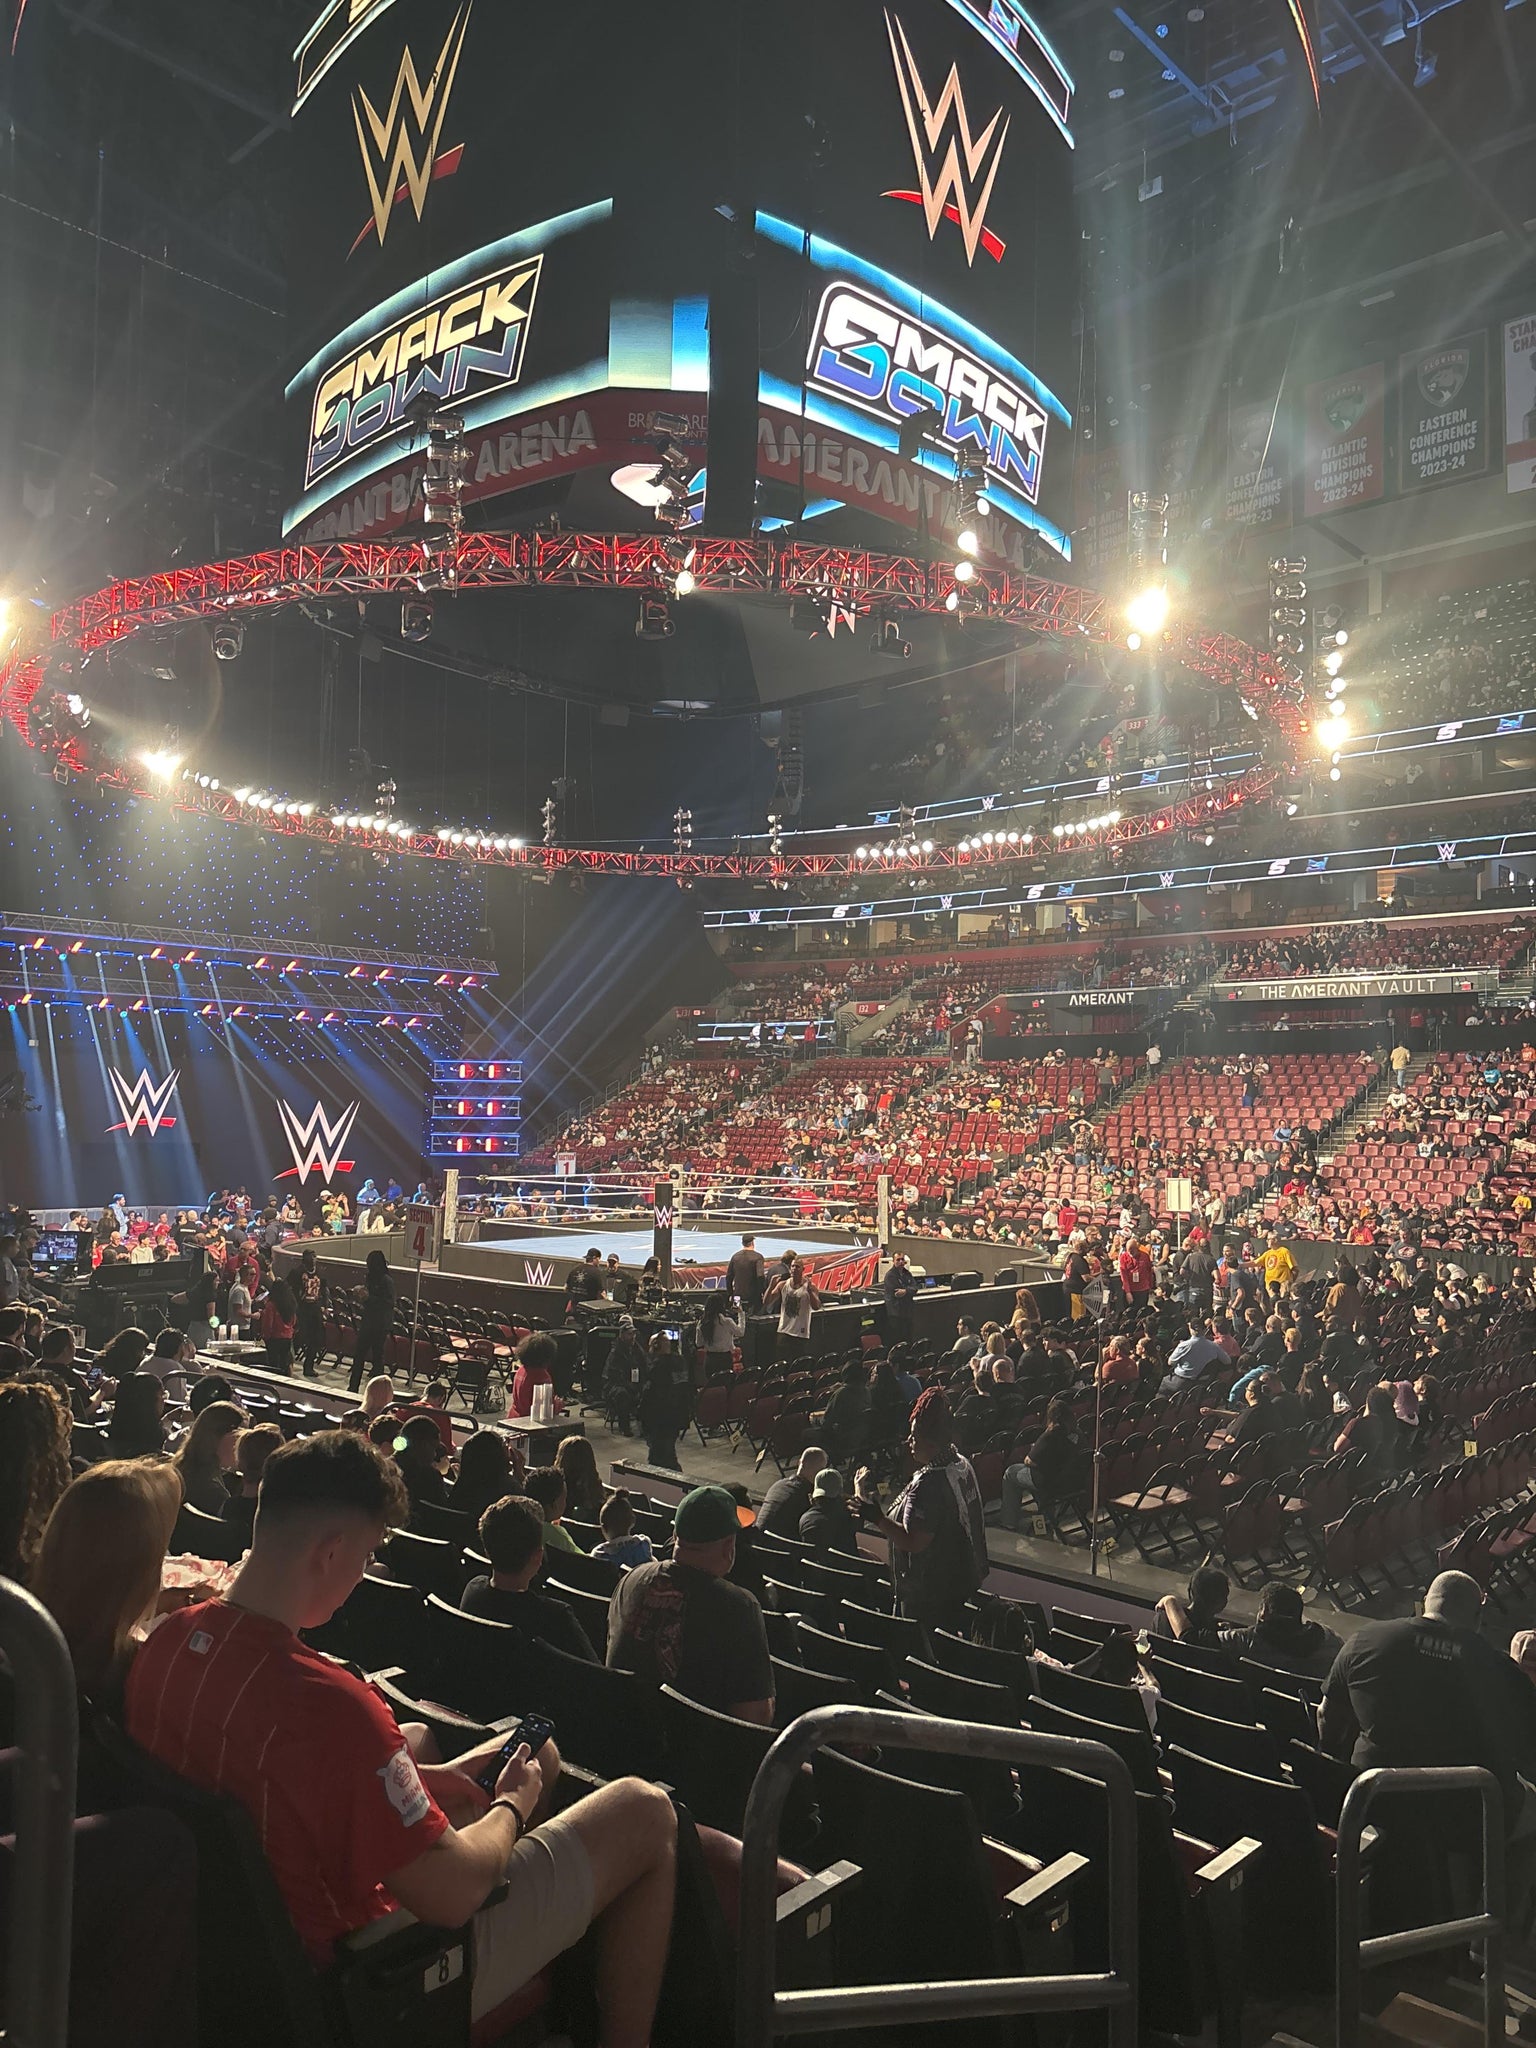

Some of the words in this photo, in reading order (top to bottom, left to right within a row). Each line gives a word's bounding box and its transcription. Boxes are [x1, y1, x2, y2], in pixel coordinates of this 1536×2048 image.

[313, 268, 538, 439] SMACK
[1424, 353, 1463, 372] FLORIDA
[824, 294, 1046, 454] SMACK
[309, 322, 522, 477] DOWN
[814, 341, 1039, 496] DOWN
[1419, 407, 1467, 433] EASTERN
[475, 409, 598, 483] ARENA
[1409, 420, 1478, 450] CONFERENCE
[1320, 437, 1368, 461] ATLANTIC
[1411, 436, 1476, 465] CHAMPIONS
[758, 416, 943, 520] AMERANT
[1321, 452, 1366, 475] DIVISION
[1420, 454, 1466, 478] 2023-24
[1233, 466, 1274, 489] EASTERN
[1314, 464, 1374, 491] CHAMPIONS
[1225, 478, 1283, 505] CONFERENCE
[1322, 481, 1365, 504] 2023-24
[1226, 492, 1281, 518] CHAMPIONS
[1069, 991, 1134, 1006] AMERANT
[1259, 986, 1287, 999] THE
[1291, 982, 1372, 998] AMERANT
[1378, 979, 1437, 994] VAULT
[563, 1161, 569, 1175] 1
[409, 1207, 434, 1225] SECTION
[412, 1225, 425, 1257] 4
[1035, 1518, 1044, 1530] G
[439, 1953, 449, 1983] 8
